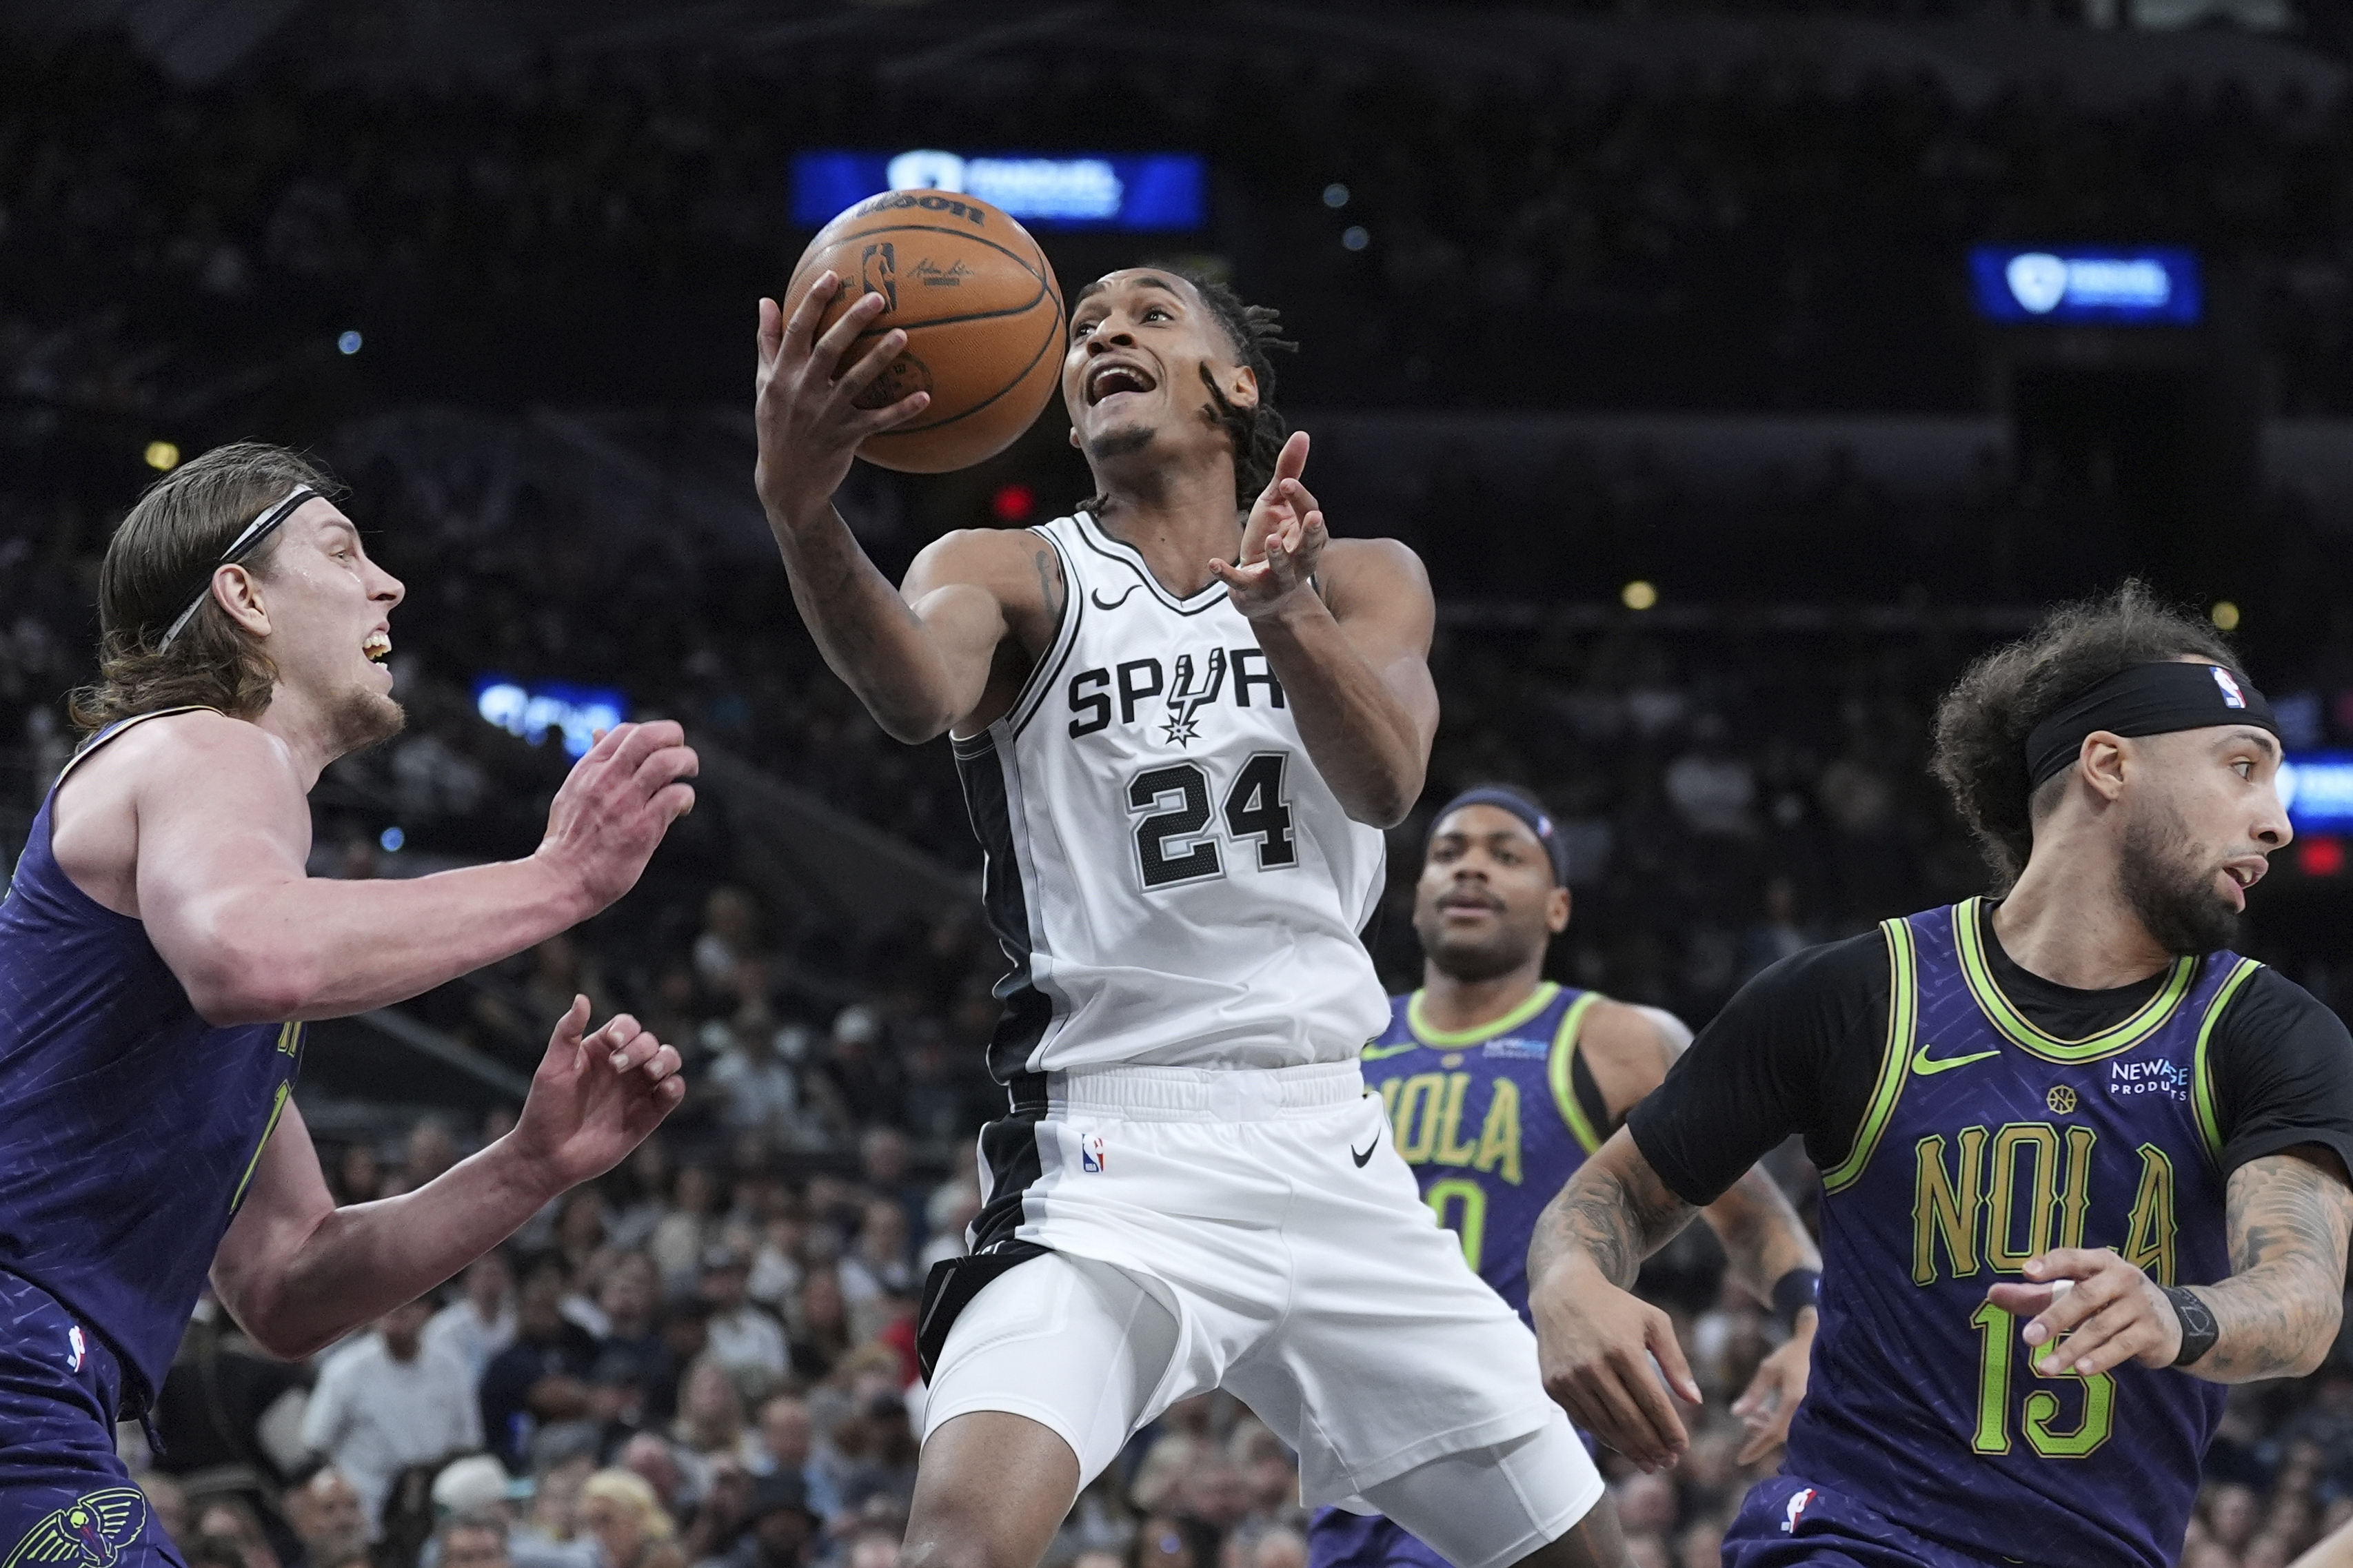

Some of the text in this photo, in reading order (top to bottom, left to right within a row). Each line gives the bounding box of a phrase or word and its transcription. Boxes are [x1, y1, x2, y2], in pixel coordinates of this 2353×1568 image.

[1068, 646, 1285, 750] SPUR
[1123, 750, 1300, 894] 24
[2110, 1080, 2188, 1101] PRODUTS
[1911, 1121, 2179, 1287] NOLA
[1970, 1298, 2117, 1458] 15
